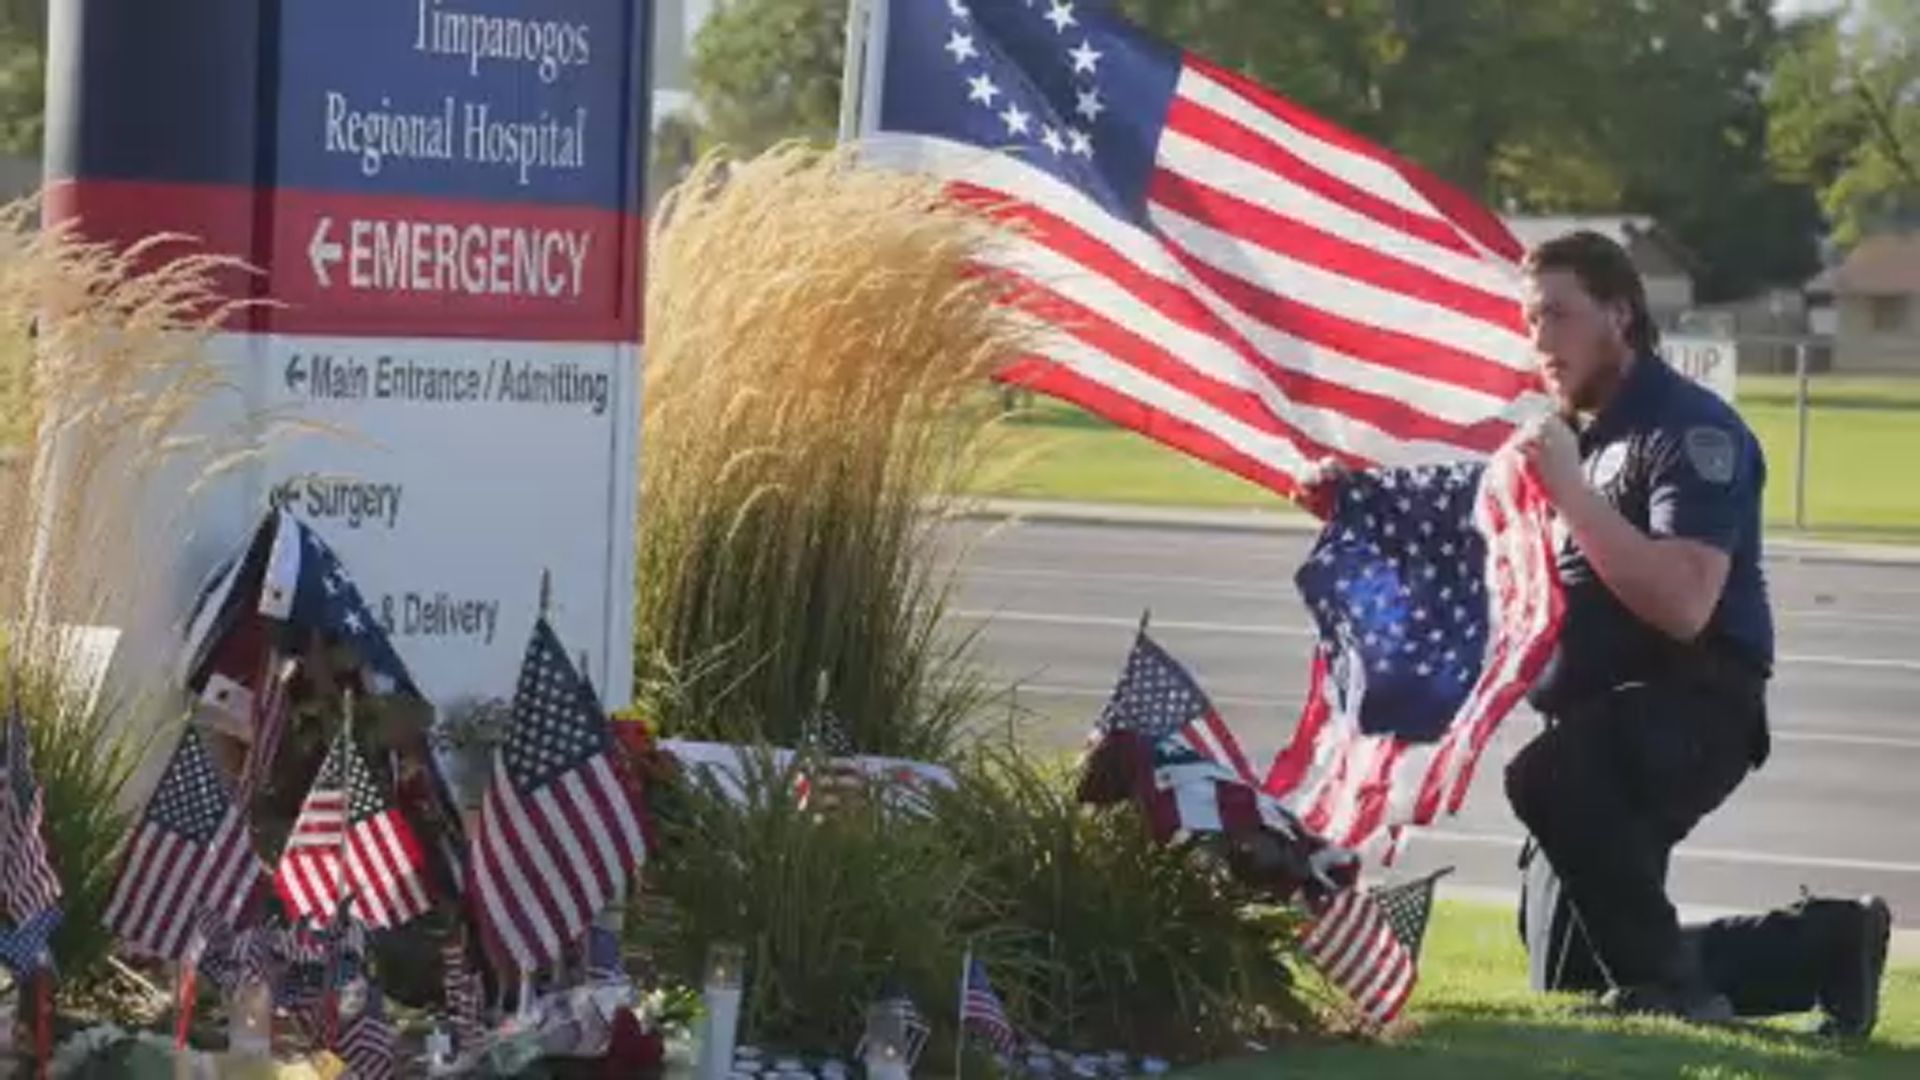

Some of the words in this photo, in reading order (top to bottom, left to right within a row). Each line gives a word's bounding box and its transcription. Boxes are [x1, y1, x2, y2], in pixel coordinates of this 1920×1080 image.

[413, 0, 590, 83] Timpanogos
[325, 92, 455, 175] Regional
[464, 103, 586, 184] Hospital
[350, 219, 589, 296] EMERGENCY
[310, 354, 368, 398] Main
[375, 357, 479, 401] Entrance
[498, 361, 609, 413] Admitting
[306, 479, 402, 526] Surgery
[403, 592, 498, 644] Delivery
